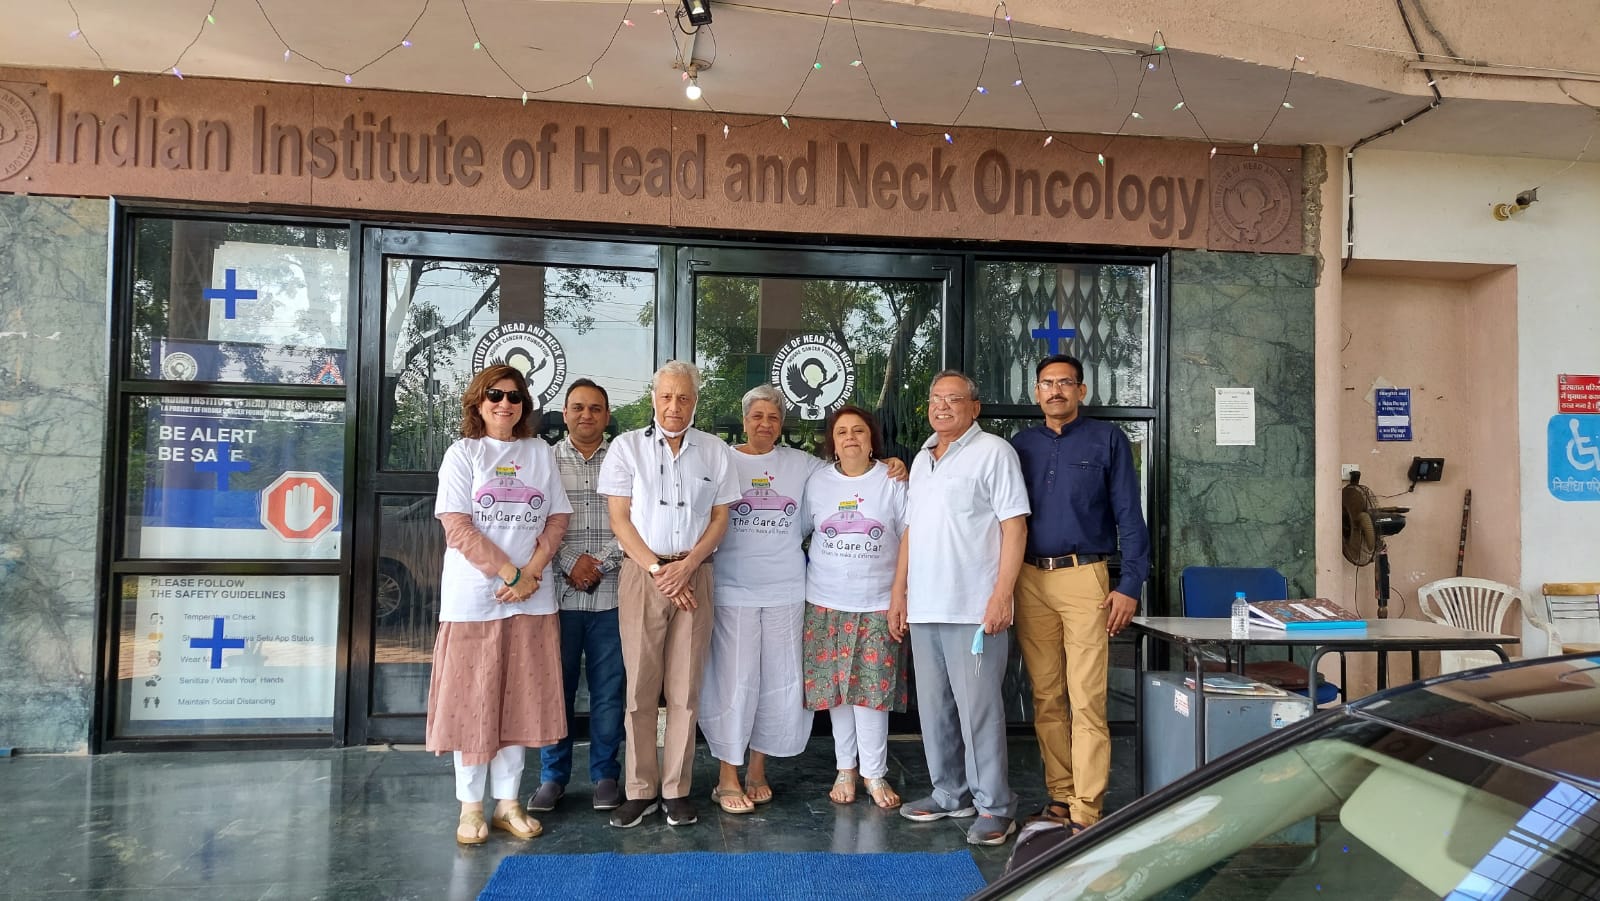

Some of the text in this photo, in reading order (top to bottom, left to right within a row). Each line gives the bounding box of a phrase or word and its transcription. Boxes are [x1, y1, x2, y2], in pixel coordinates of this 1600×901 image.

[48, 91, 230, 172] Indian
[252, 105, 485, 188] Institute
[502, 122, 559, 191] of
[573, 126, 707, 200] Head
[723, 140, 817, 206] and
[835, 142, 958, 213] Neck
[972, 147, 1206, 241] Oncology
[790, 337, 802, 348] OF
[803, 334, 825, 344] HEAD
[825, 338, 843, 353] AND
[473, 323, 565, 401] STITUTE OF HEAD AND NECK ONCOLOGY
[771, 344, 792, 385] INSTITUTE
[840, 351, 854, 373] NECK
[830, 373, 855, 412] ONCOLOGY
[159, 425, 257, 444] BE ALERT
[158, 446, 244, 463] BE SAE
[474, 510, 493, 522] The
[495, 510, 521, 522] Care
[732, 516, 793, 528] The Care Car
[836, 540, 861, 551] Care
[864, 541, 882, 552] Car
[150, 578, 245, 588] PLEASE FOLLOW
[150, 590, 286, 600] THE SAFETY GUIDELINES
[291, 634, 314, 642] Status
[181, 655, 200, 663] Wear
[260, 676, 284, 684] Hands
[178, 698, 209, 706] Maintain
[237, 697, 276, 706] Distancing
